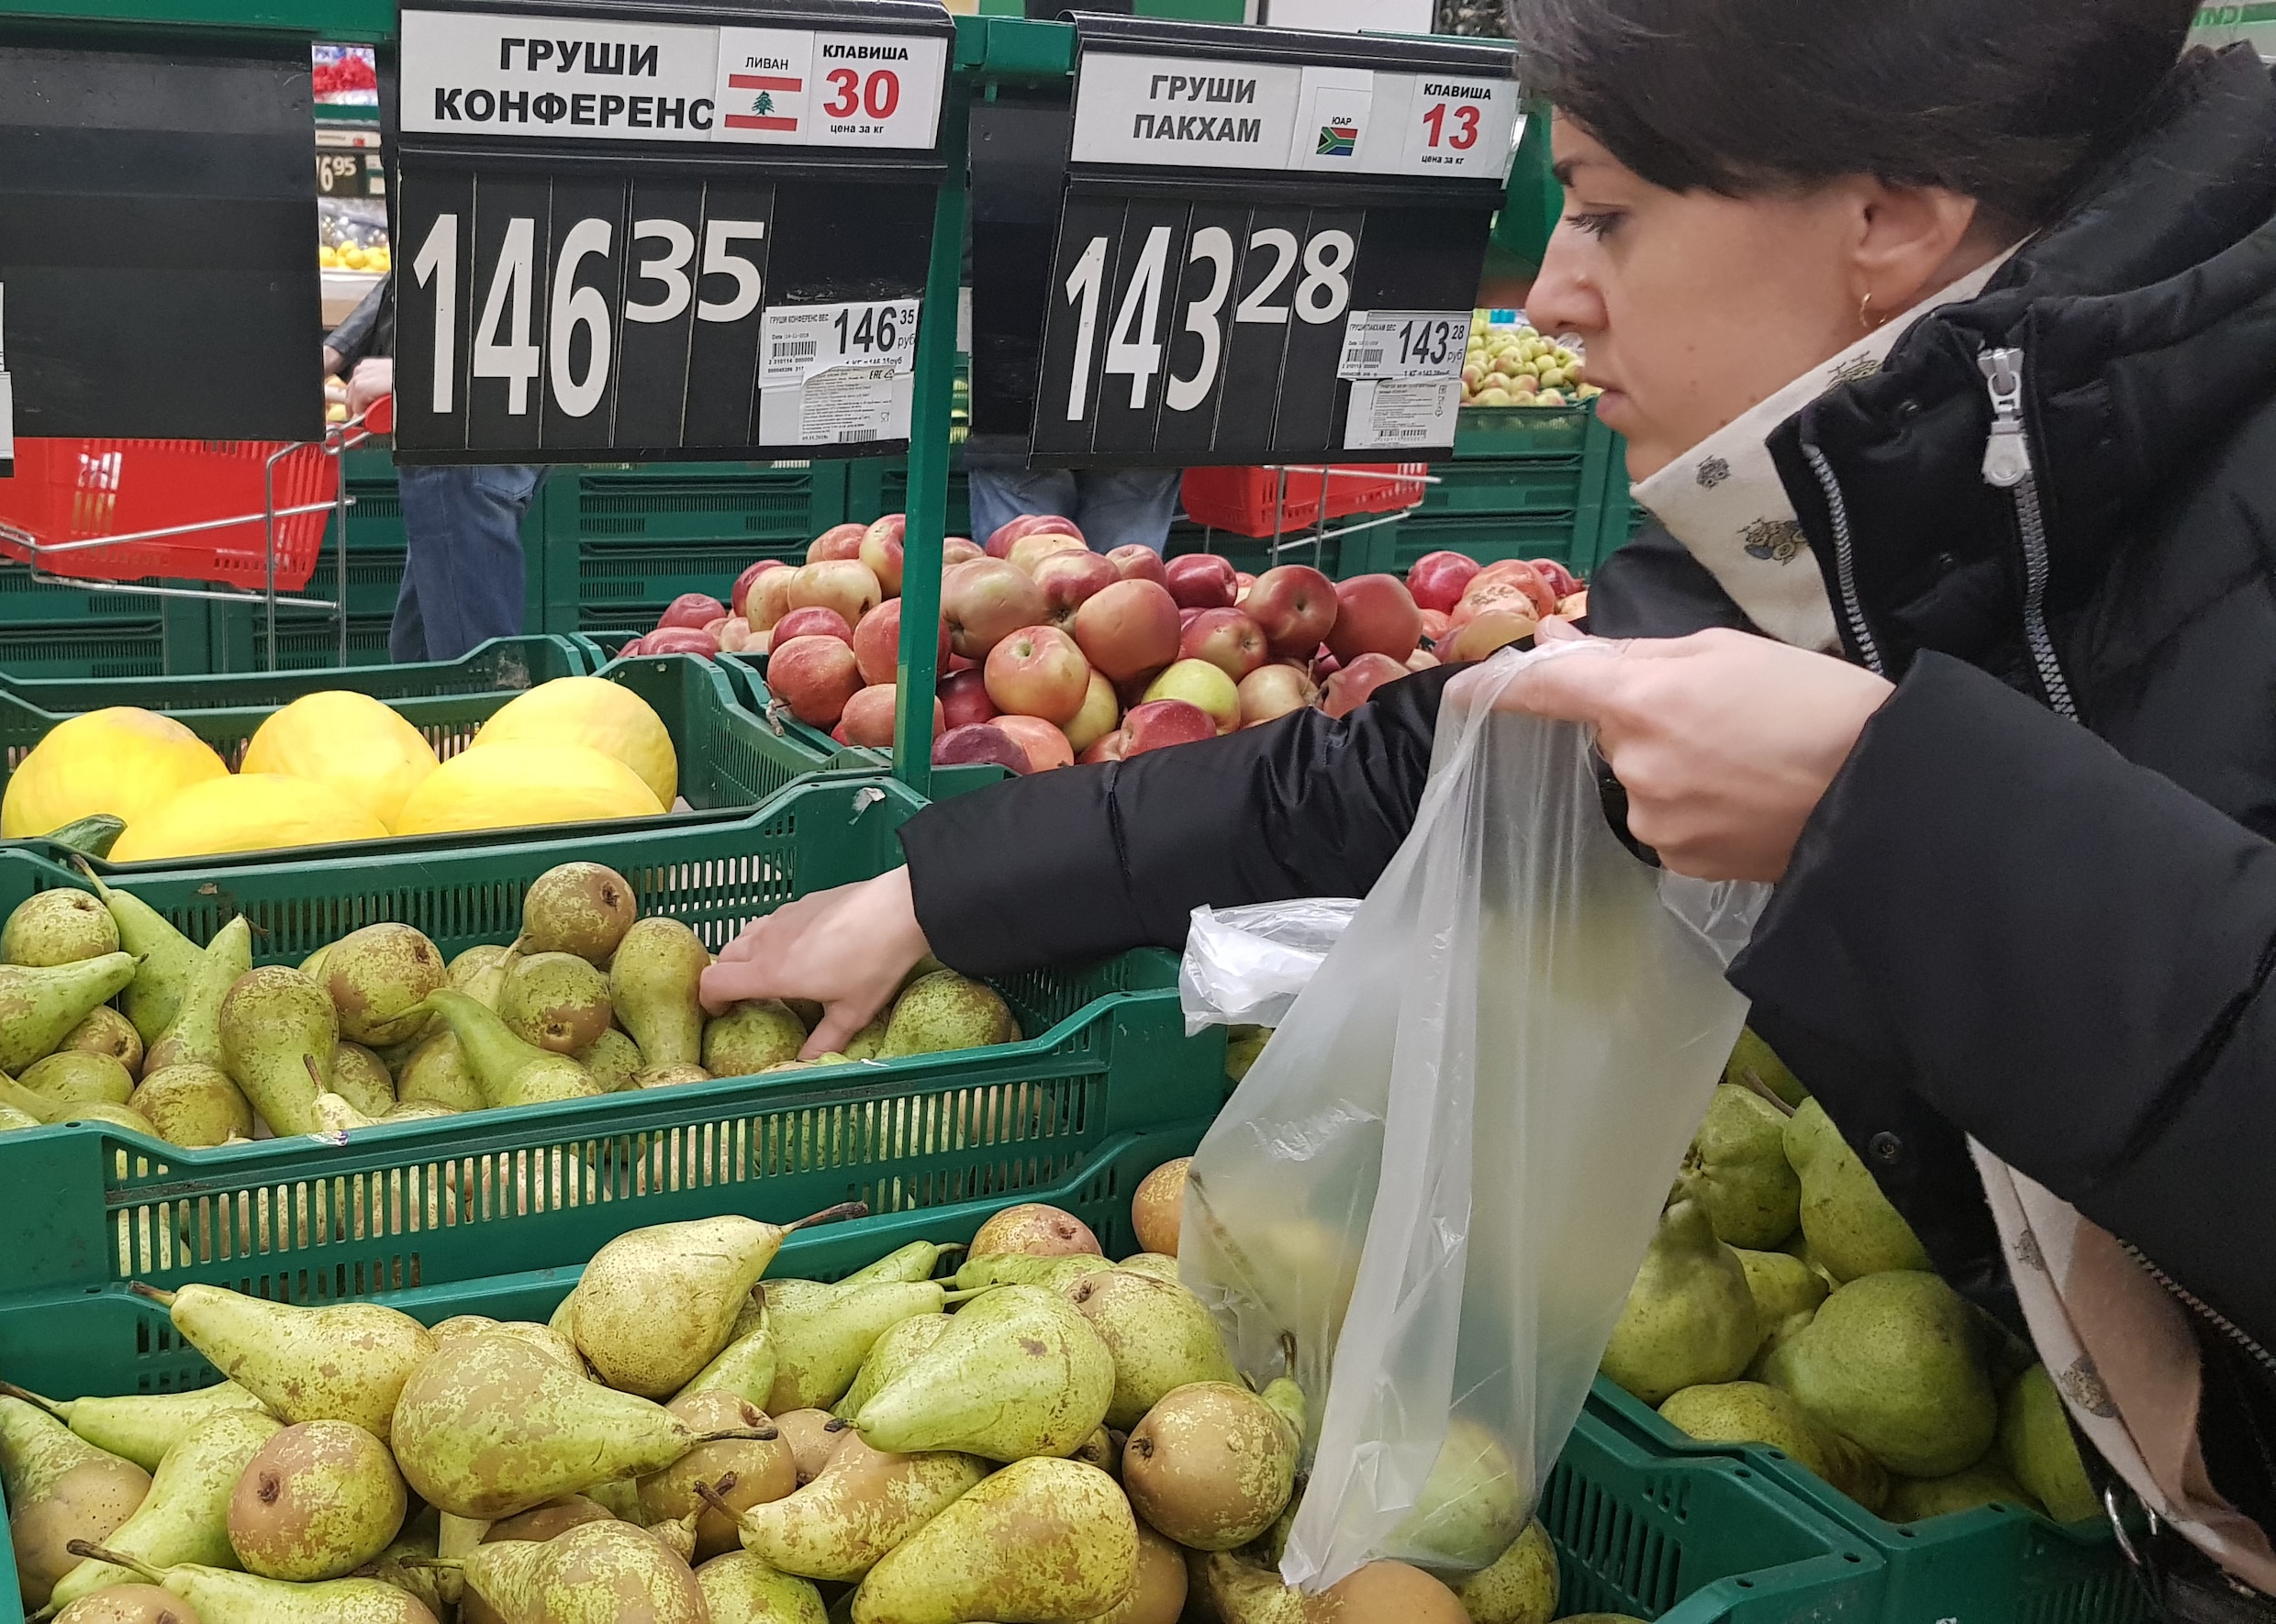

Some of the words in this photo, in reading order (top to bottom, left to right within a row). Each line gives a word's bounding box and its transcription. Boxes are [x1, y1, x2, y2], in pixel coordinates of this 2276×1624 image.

[500, 38, 658, 77] ГРУШИ
[744, 57, 788, 71] ЛИВАН
[822, 44, 909, 61] КЛАВИША
[822, 68, 899, 119] 30
[1149, 74, 1256, 105] ГРУШИ
[1423, 83, 1491, 100] КЛАВИША
[434, 87, 715, 130] КОНФЕРЕНС
[1331, 117, 1352, 126] ЮАР
[830, 123, 856, 134] цена
[858, 124, 870, 134] за
[873, 125, 885, 135] кг
[1132, 114, 1261, 143] ПАКХАМ
[1422, 103, 1480, 150] 13
[1421, 155, 1442, 164] цена
[1444, 156, 1453, 164] за
[1456, 157, 1465, 165] кг
[412, 214, 612, 417] 146
[624, 218, 765, 324] 35
[834, 306, 897, 355] 146
[899, 309, 915, 325] 35
[1065, 226, 1234, 421] 143
[1234, 227, 1355, 324] 28
[898, 333, 916, 349] руб
[1399, 320, 1449, 364] 143
[1451, 325, 1465, 339] 28
[1447, 349, 1463, 363] руб
